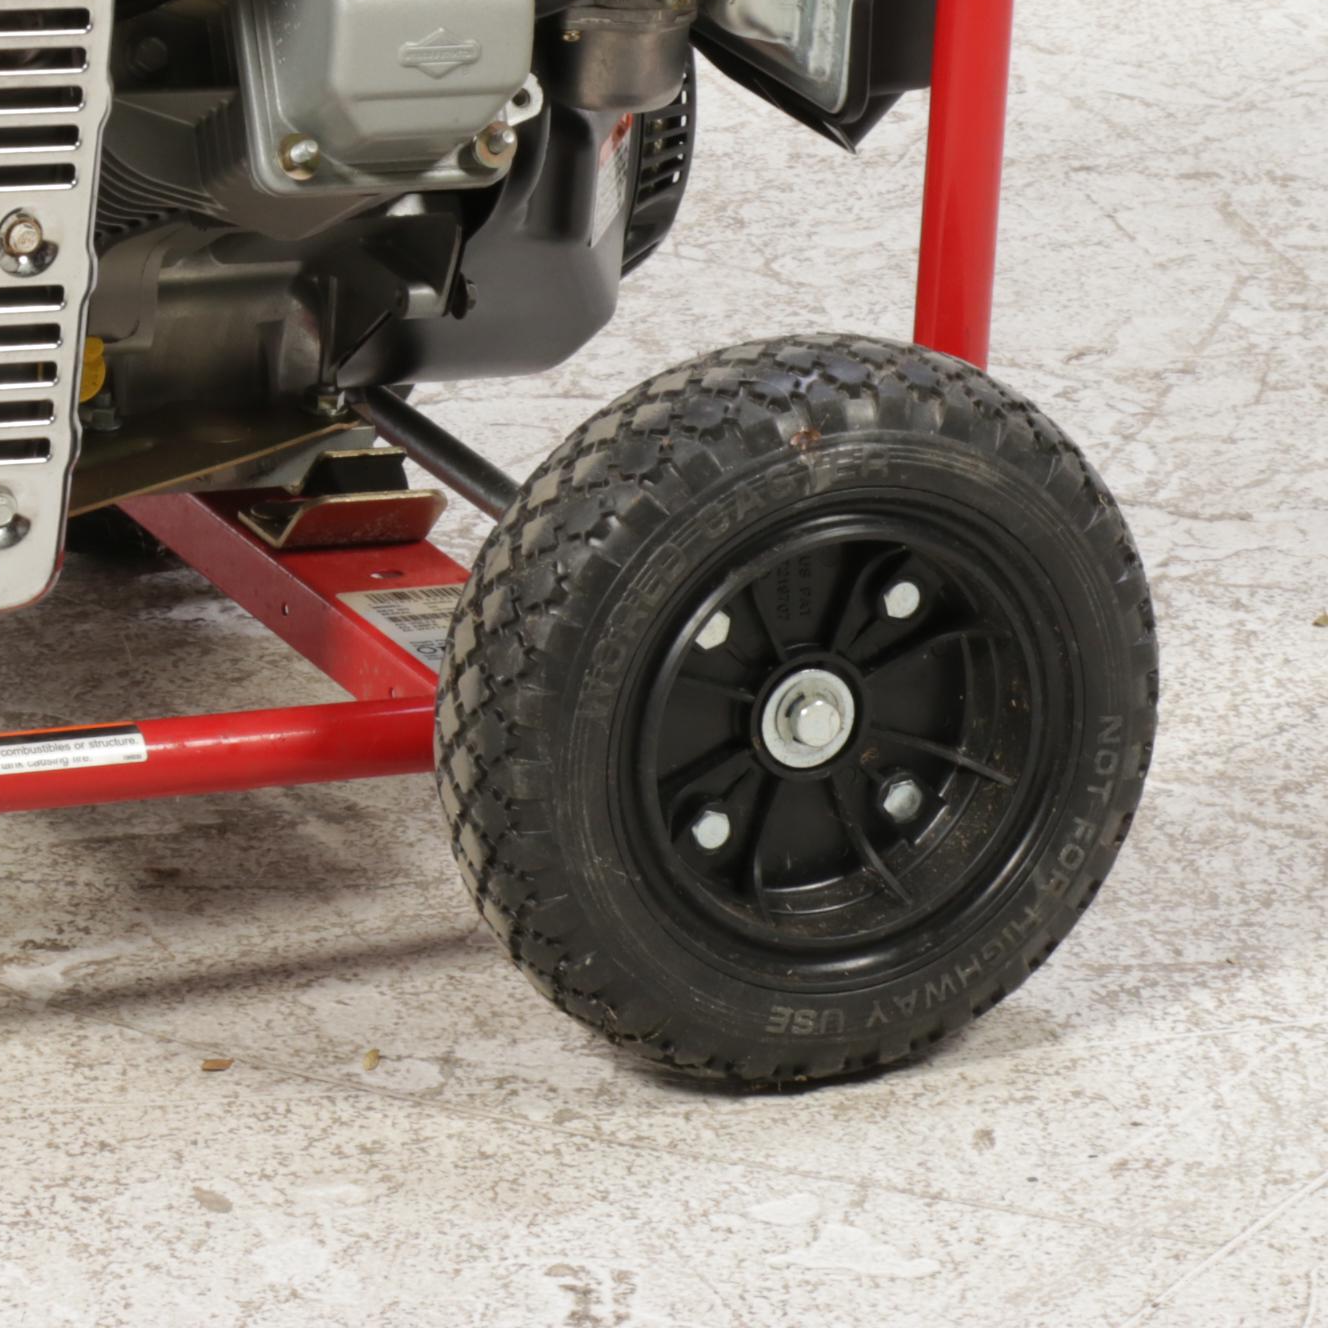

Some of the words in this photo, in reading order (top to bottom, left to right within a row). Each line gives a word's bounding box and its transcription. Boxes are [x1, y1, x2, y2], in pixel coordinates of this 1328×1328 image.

[0, 743, 71, 758] combustibles
[73, 741, 86, 750] or
[88, 736, 139, 749] structure.
[1087, 715, 1122, 803] NOT
[1043, 816, 1096, 897] FOR
[866, 904, 1042, 1027] HIGHWAY
[765, 1005, 845, 1034] USE
